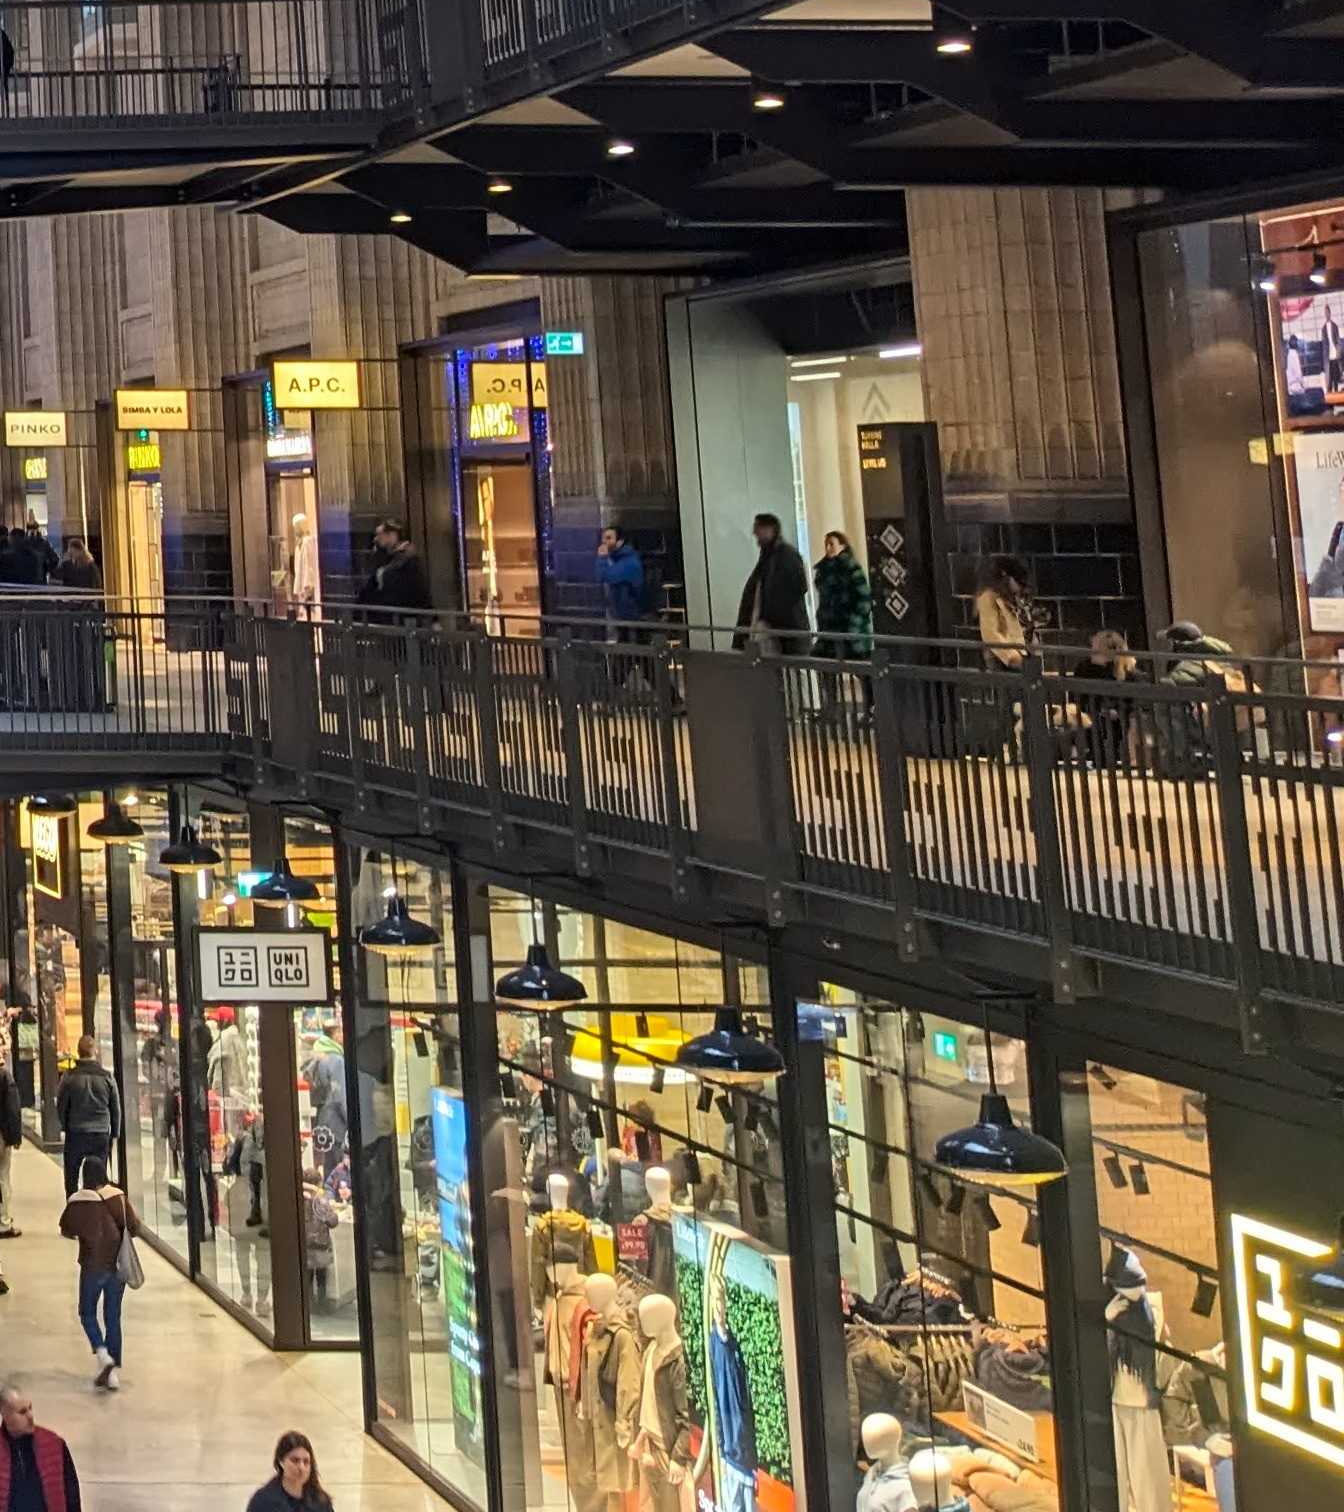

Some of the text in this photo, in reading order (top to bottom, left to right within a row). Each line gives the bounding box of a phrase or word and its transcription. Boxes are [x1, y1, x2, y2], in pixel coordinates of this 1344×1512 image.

[288, 377, 346, 393] A.P.C.
[122, 406, 183, 415] BIMBA Y LOLA
[10, 424, 61, 434] PINKO
[273, 952, 300, 966] UNI
[274, 968, 303, 983] QLO
